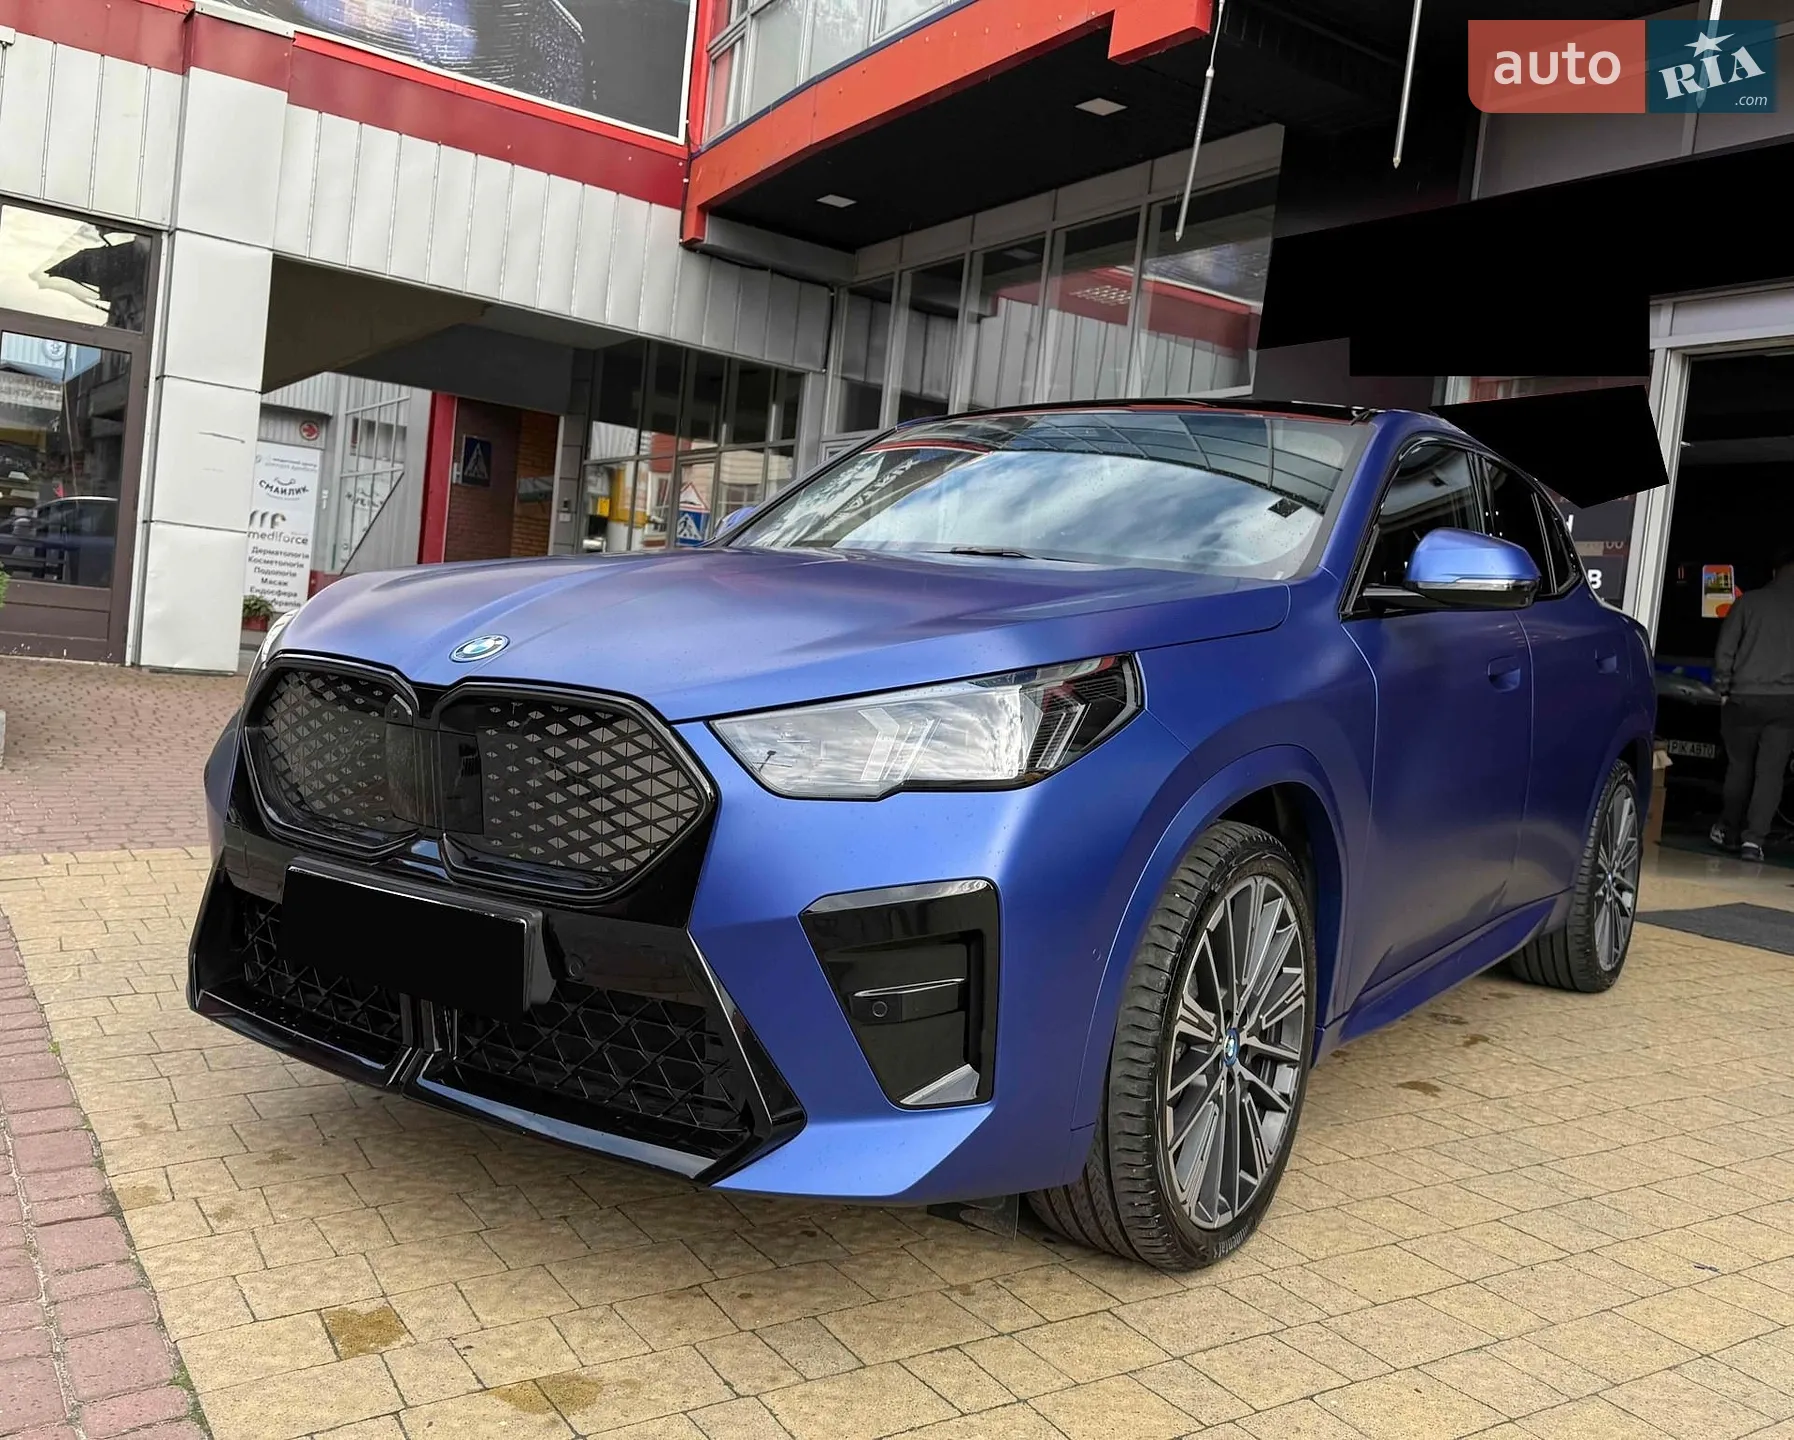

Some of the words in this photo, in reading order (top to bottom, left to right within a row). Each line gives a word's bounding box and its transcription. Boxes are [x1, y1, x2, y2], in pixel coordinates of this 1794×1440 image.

[247, 531, 309, 545] mediforce
[251, 546, 310, 558] Дерматологія
[248, 556, 305, 568] Косметологія
[261, 577, 289, 586] Масаж
